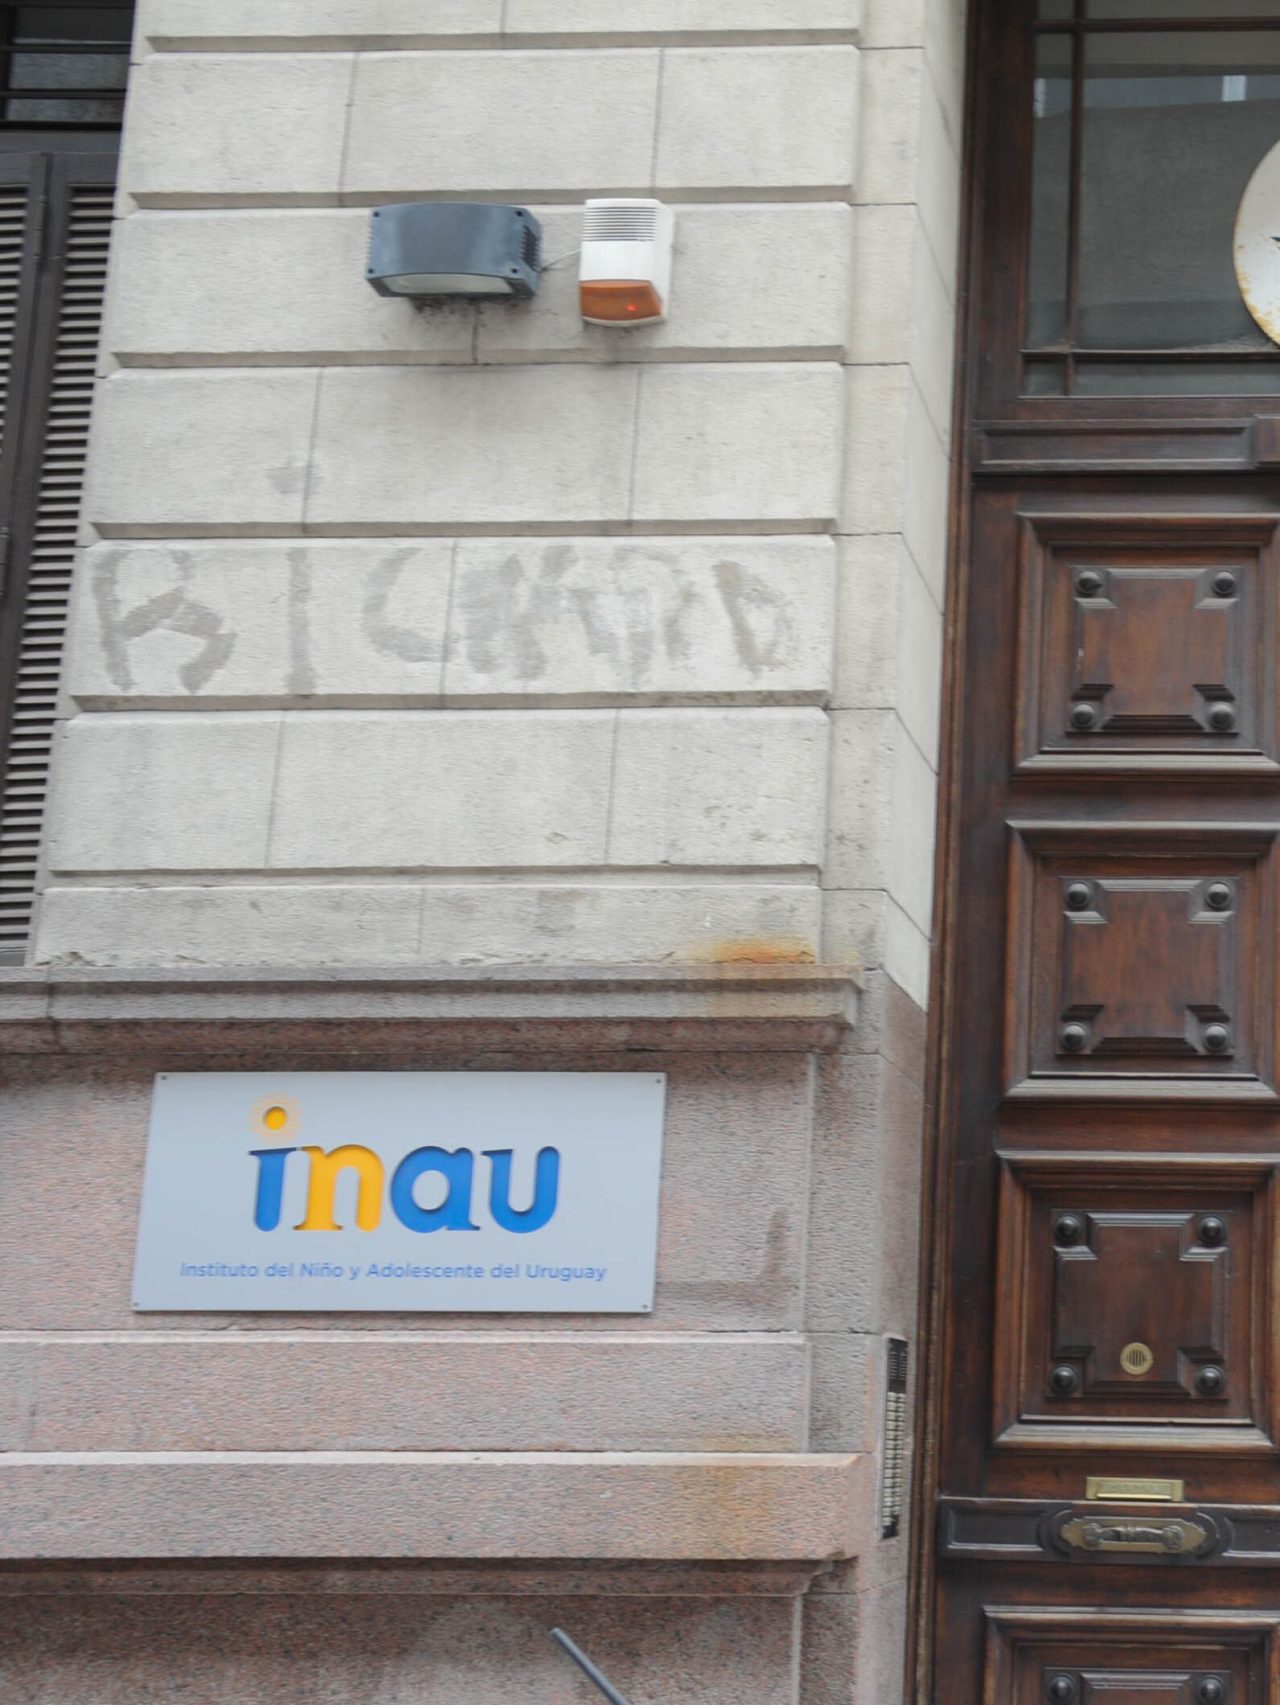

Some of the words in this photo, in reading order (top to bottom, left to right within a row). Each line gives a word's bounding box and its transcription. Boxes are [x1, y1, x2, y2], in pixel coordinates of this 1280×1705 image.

[249, 1106, 560, 1234] inau
[180, 1263, 259, 1278] Instituto
[264, 1263, 294, 1278] del
[300, 1262, 344, 1278] Niño
[349, 1266, 360, 1281] y
[366, 1263, 485, 1279] Adolescente
[490, 1263, 519, 1279] del
[526, 1264, 607, 1282] Uruguay
